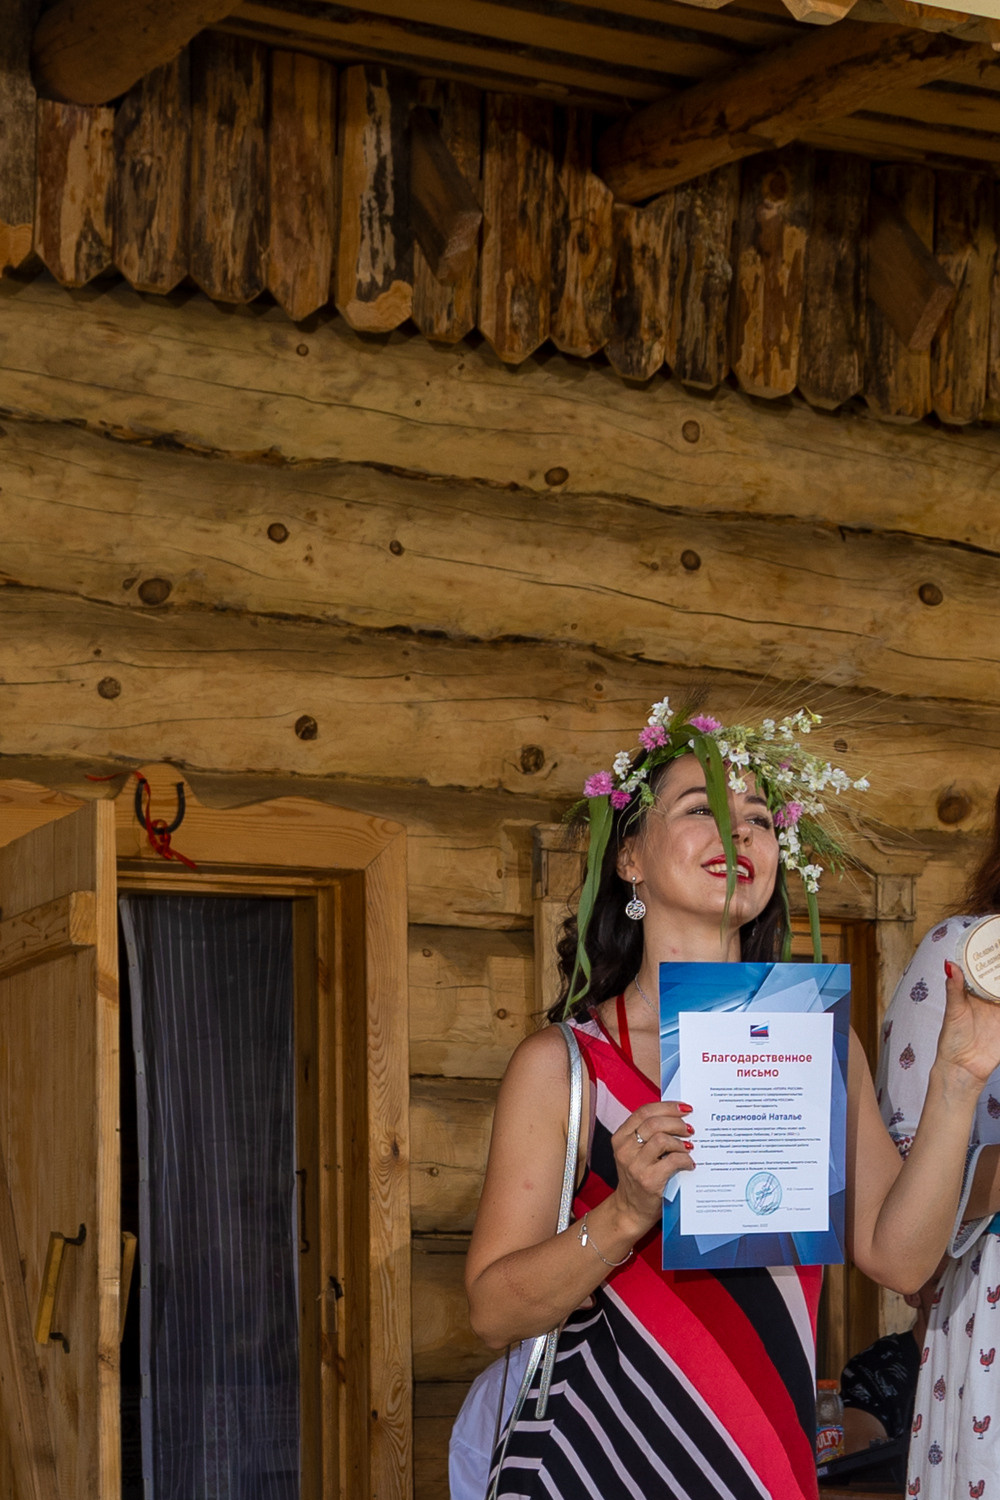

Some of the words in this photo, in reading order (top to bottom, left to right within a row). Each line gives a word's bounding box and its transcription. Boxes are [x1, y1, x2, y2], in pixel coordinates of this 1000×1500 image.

[701, 1052, 813, 1064] Благодарственное
[737, 1069, 779, 1077] письмо
[711, 1113, 767, 1122] Герасимовой
[769, 1113, 802, 1121] Наталье
